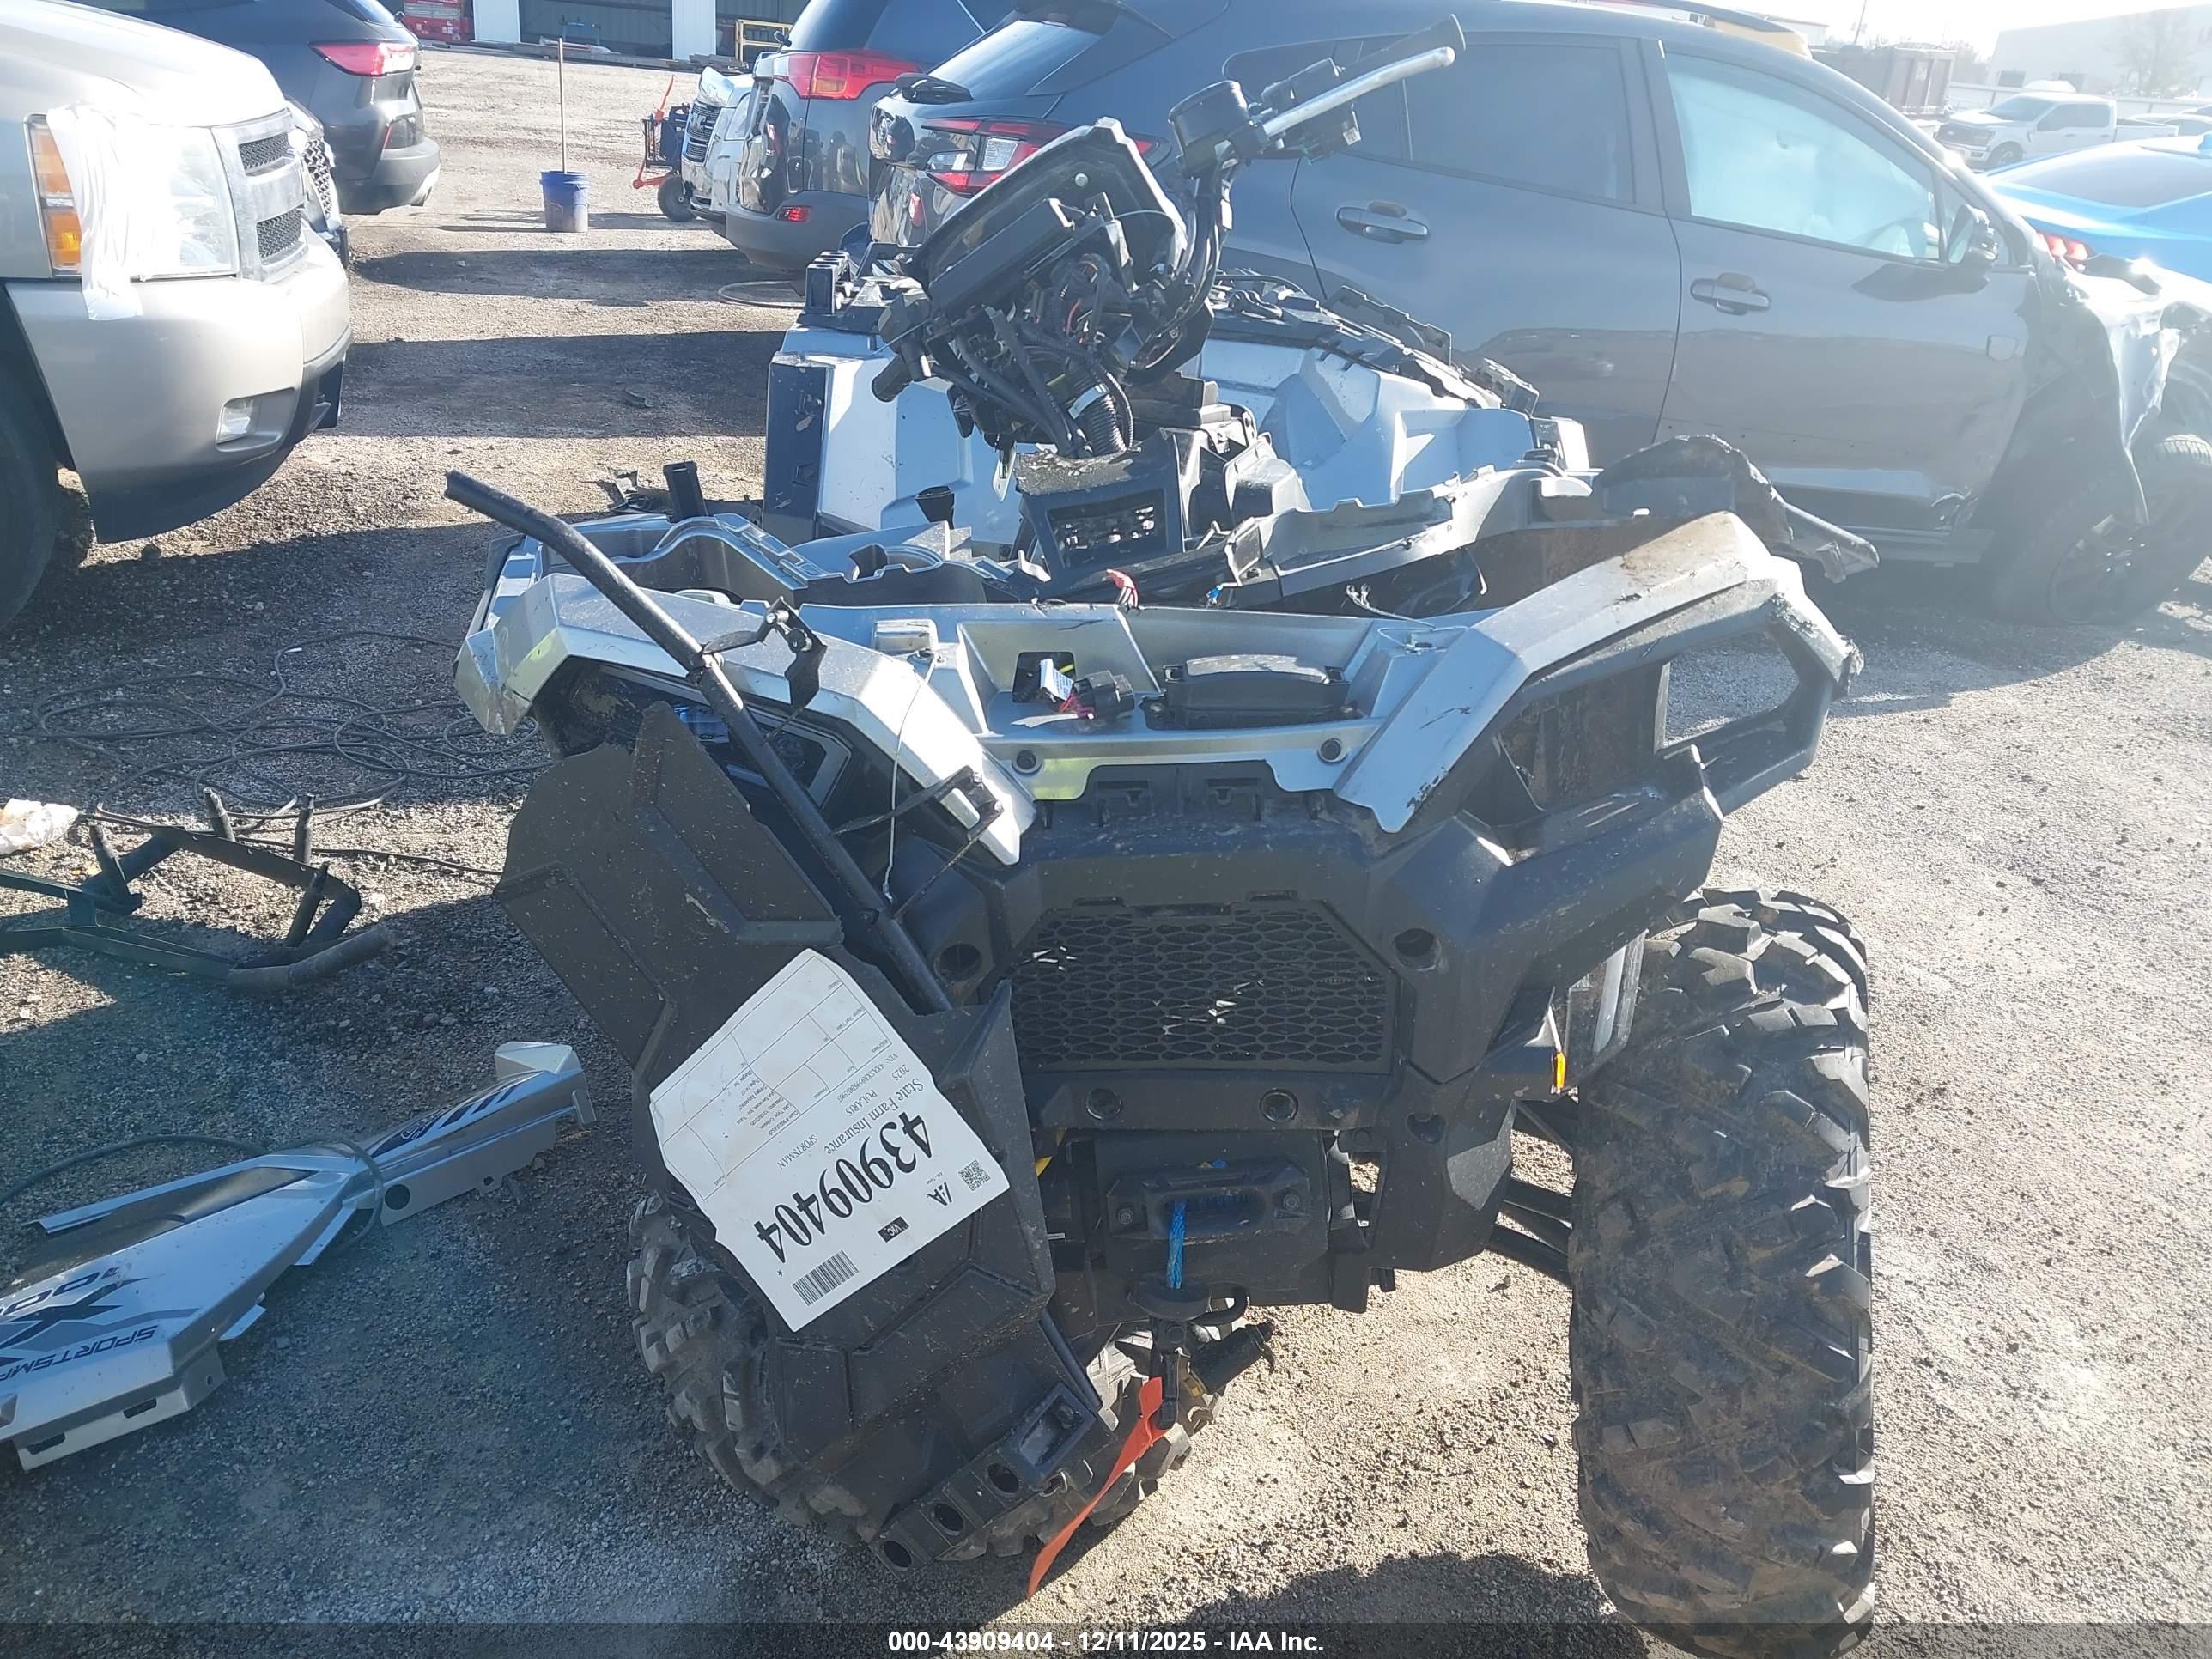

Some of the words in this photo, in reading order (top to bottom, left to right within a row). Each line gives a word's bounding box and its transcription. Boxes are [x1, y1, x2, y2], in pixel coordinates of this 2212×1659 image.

[890, 1064, 909, 1080] 2025
[845, 1089, 878, 1116] POLARIS
[894, 1078, 924, 1101] State
[867, 1097, 898, 1121] Farm
[823, 1116, 872, 1154] Insurance
[776, 1133, 817, 1169] SPORTSMAN
[753, 1112, 933, 1263] 43909404
